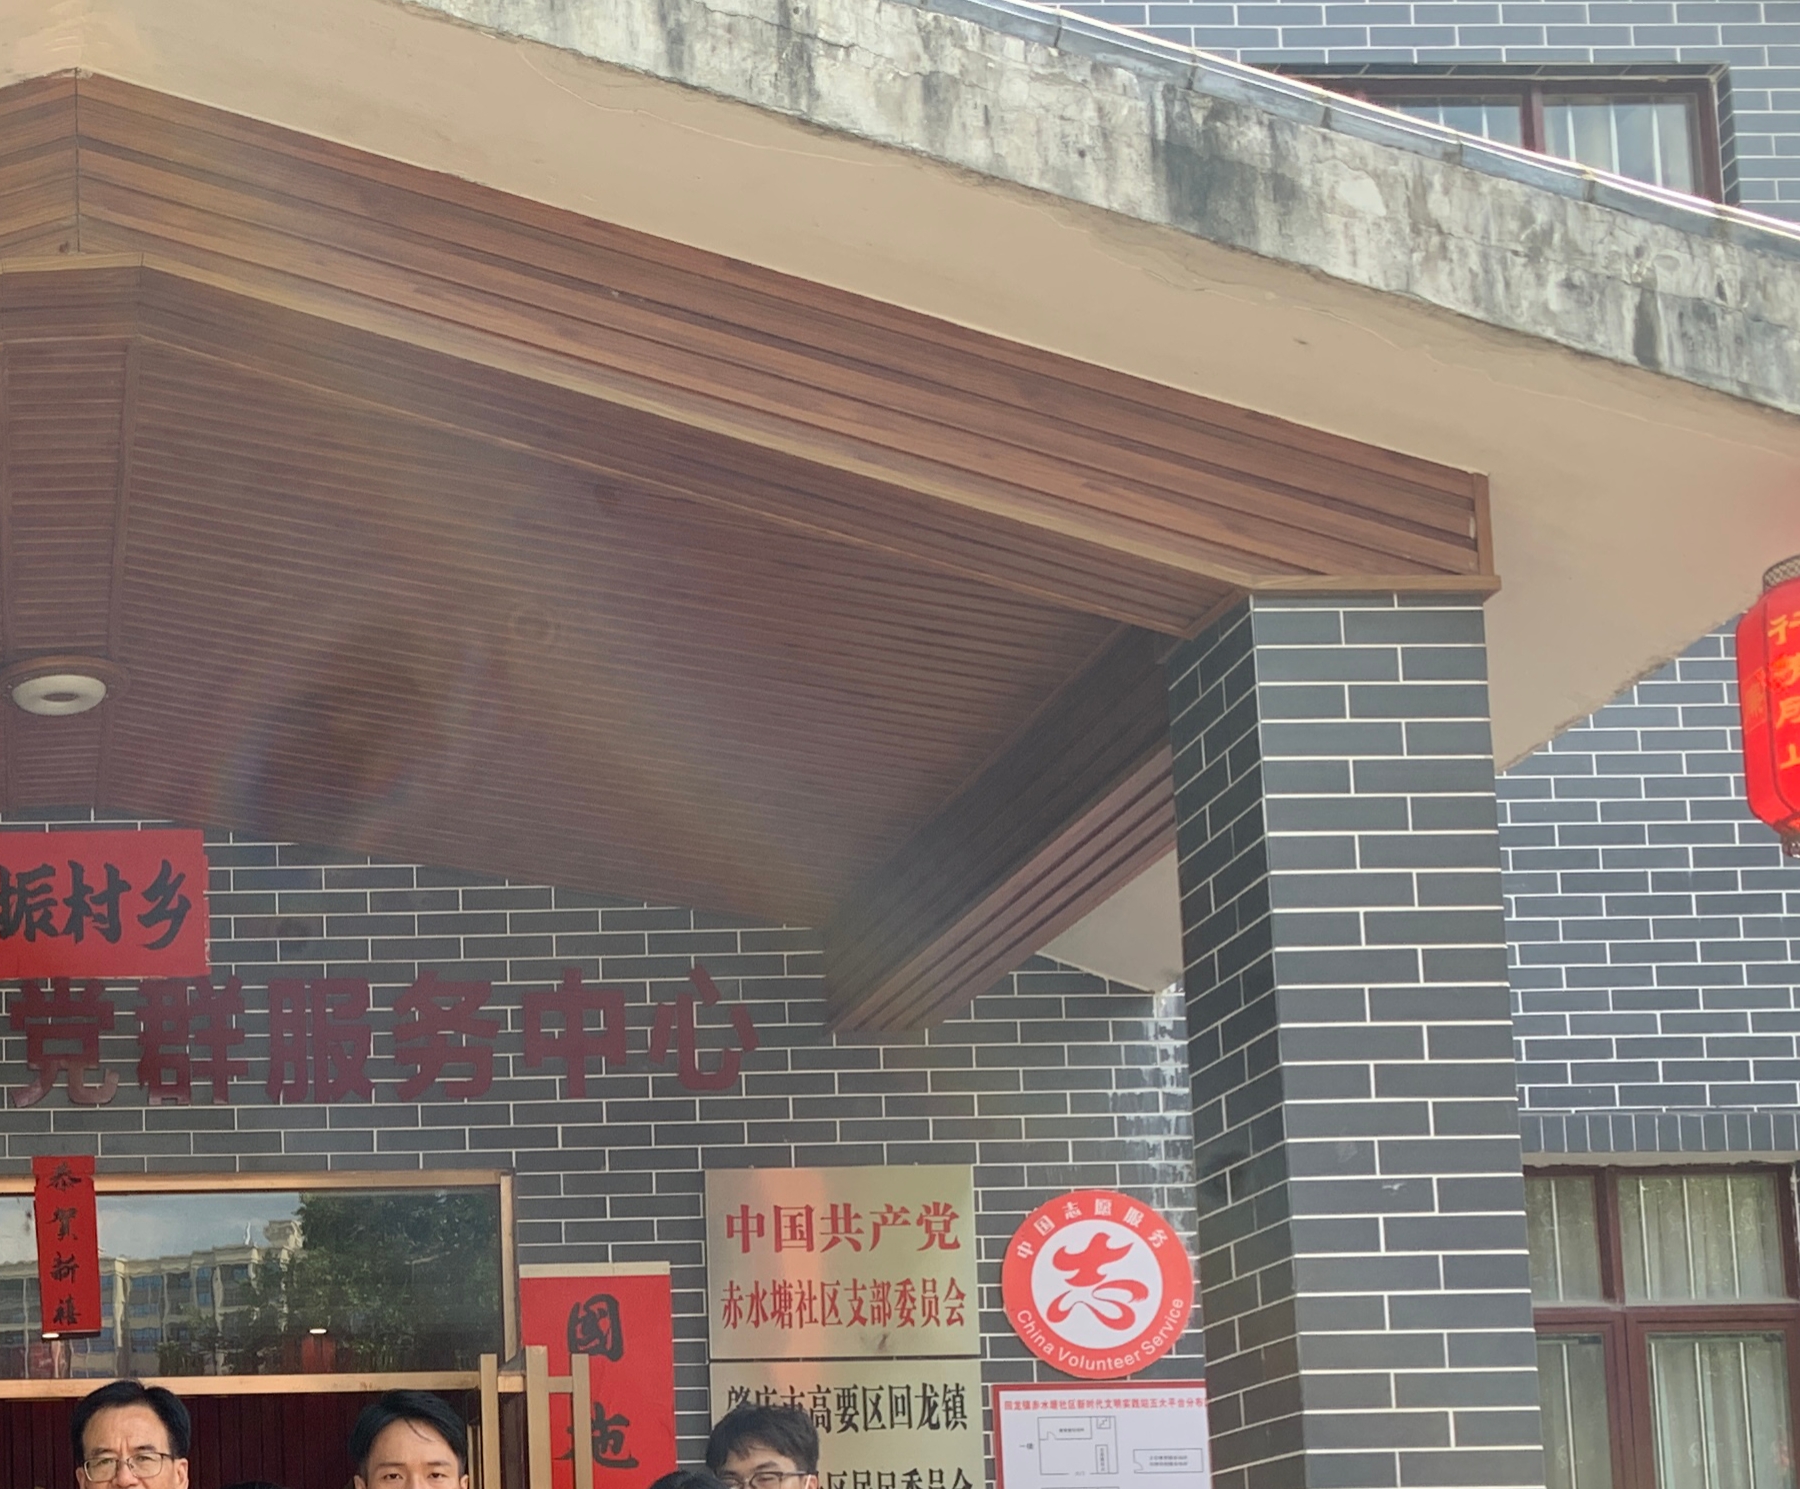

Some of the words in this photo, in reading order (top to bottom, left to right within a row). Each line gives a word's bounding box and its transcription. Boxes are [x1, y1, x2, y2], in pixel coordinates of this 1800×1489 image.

[726, 1201, 961, 1253] 中国共产党
[721, 1277, 966, 1330] 赤水塘社区支部委员会
[1017, 1309, 1054, 1355] China
[1058, 1347, 1142, 1371] Volunteer
[1141, 1298, 1184, 1355] Service
